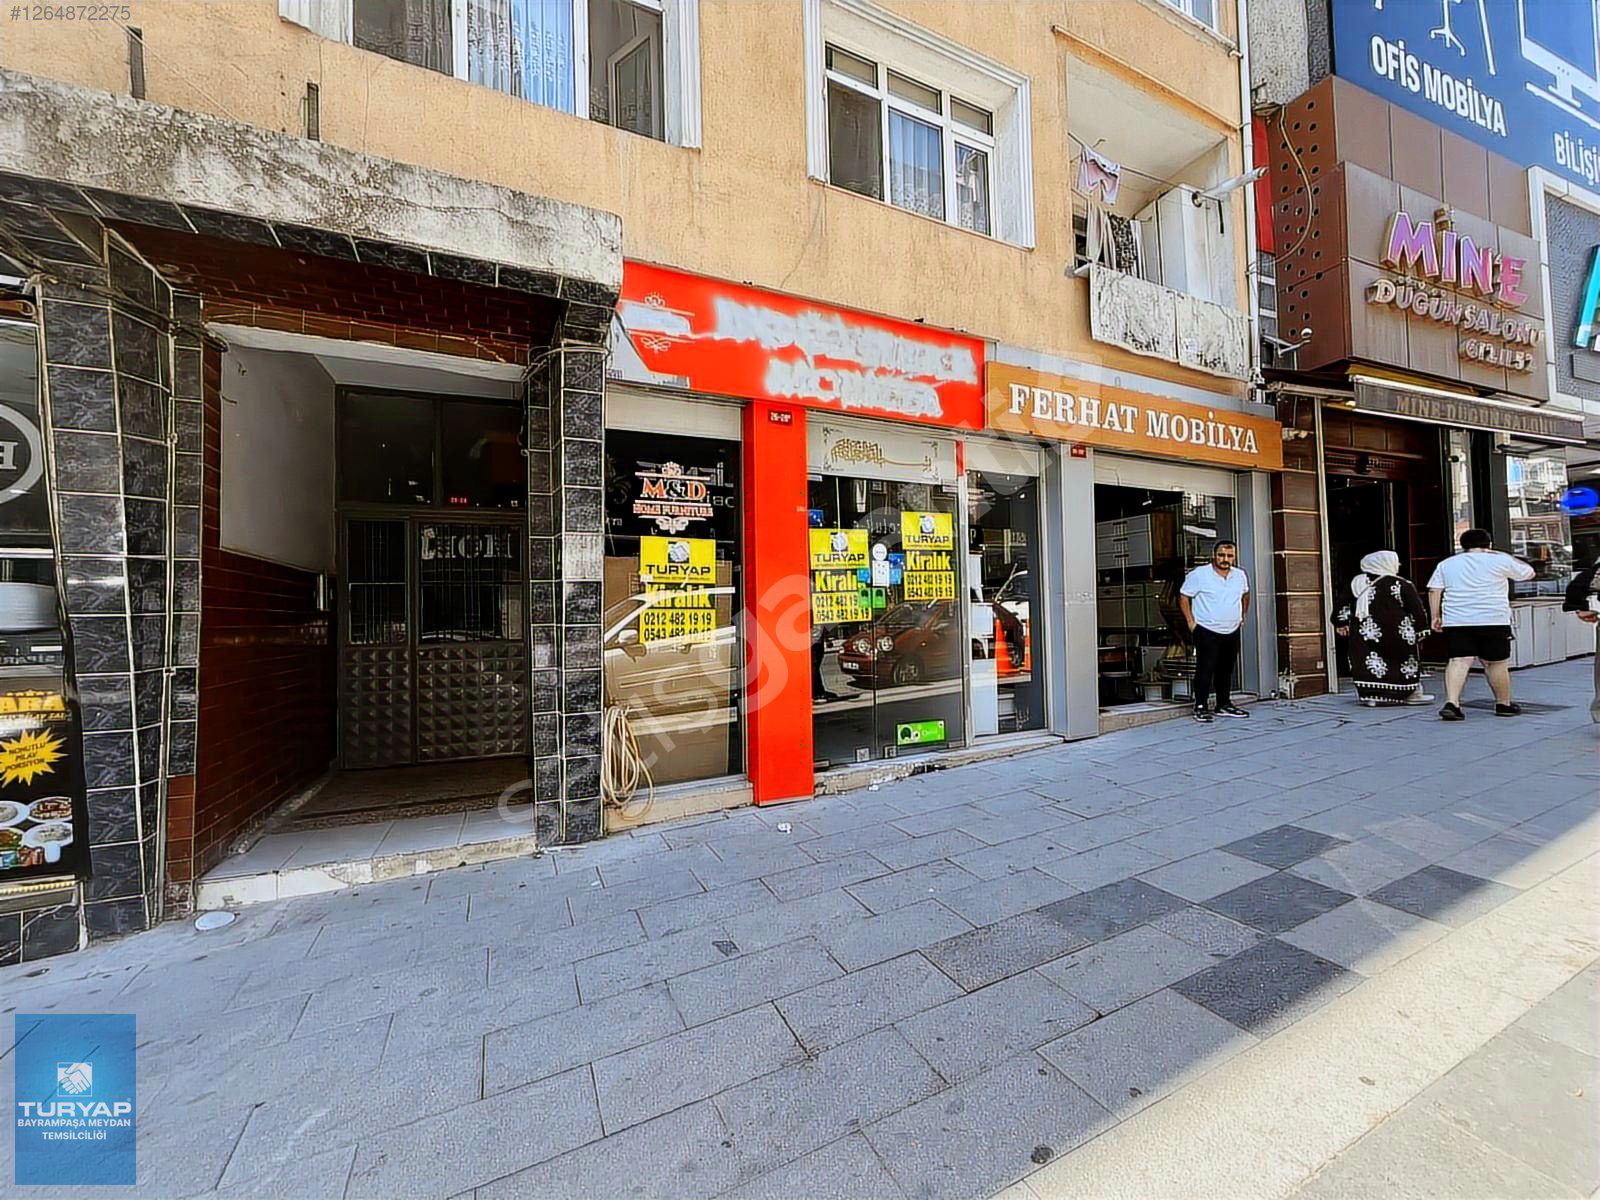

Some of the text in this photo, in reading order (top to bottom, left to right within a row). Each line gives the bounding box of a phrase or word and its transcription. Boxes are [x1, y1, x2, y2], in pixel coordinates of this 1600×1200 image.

[1371, 35, 1507, 137] OFİS MOBİLYA
[1554, 130, 1600, 186] BİLİŞİ
[1367, 276, 1462, 325] DÜĞÜN
[1008, 382, 1259, 454] FERHAT MOBİLYA
[640, 477, 706, 500] M&D
[633, 503, 713, 517] HOME FURNITURE
[905, 535, 950, 543] TURYAP
[814, 553, 865, 562] TURYAP
[906, 551, 951, 570] Kiralık
[645, 564, 711, 576] TURYAP
[815, 570, 858, 592] Kiralı
[644, 612, 712, 626] 0212 482 19 19
[644, 627, 666, 641] 0543
